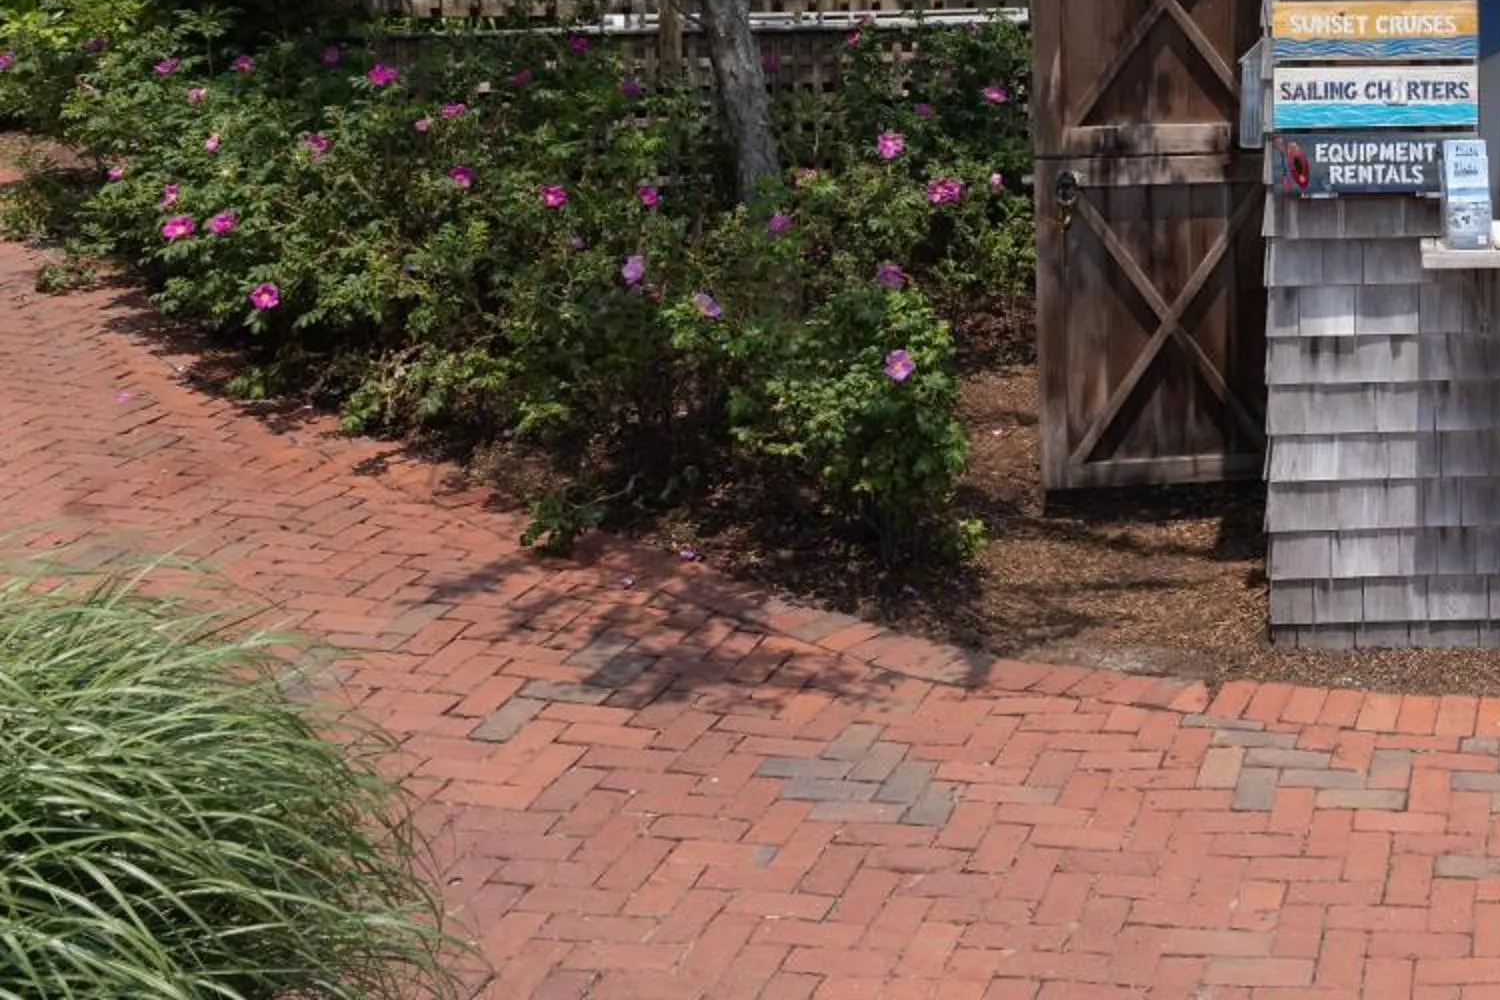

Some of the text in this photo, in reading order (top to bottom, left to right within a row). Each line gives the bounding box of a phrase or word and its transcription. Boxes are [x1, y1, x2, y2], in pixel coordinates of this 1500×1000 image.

[1290, 14, 1457, 34] SUNSET CRUISES
[1280, 81, 1470, 101] SAILING CHRTERS
[1315, 142, 1437, 163] EQUIPMENT
[1329, 165, 1424, 184] RENTALS
